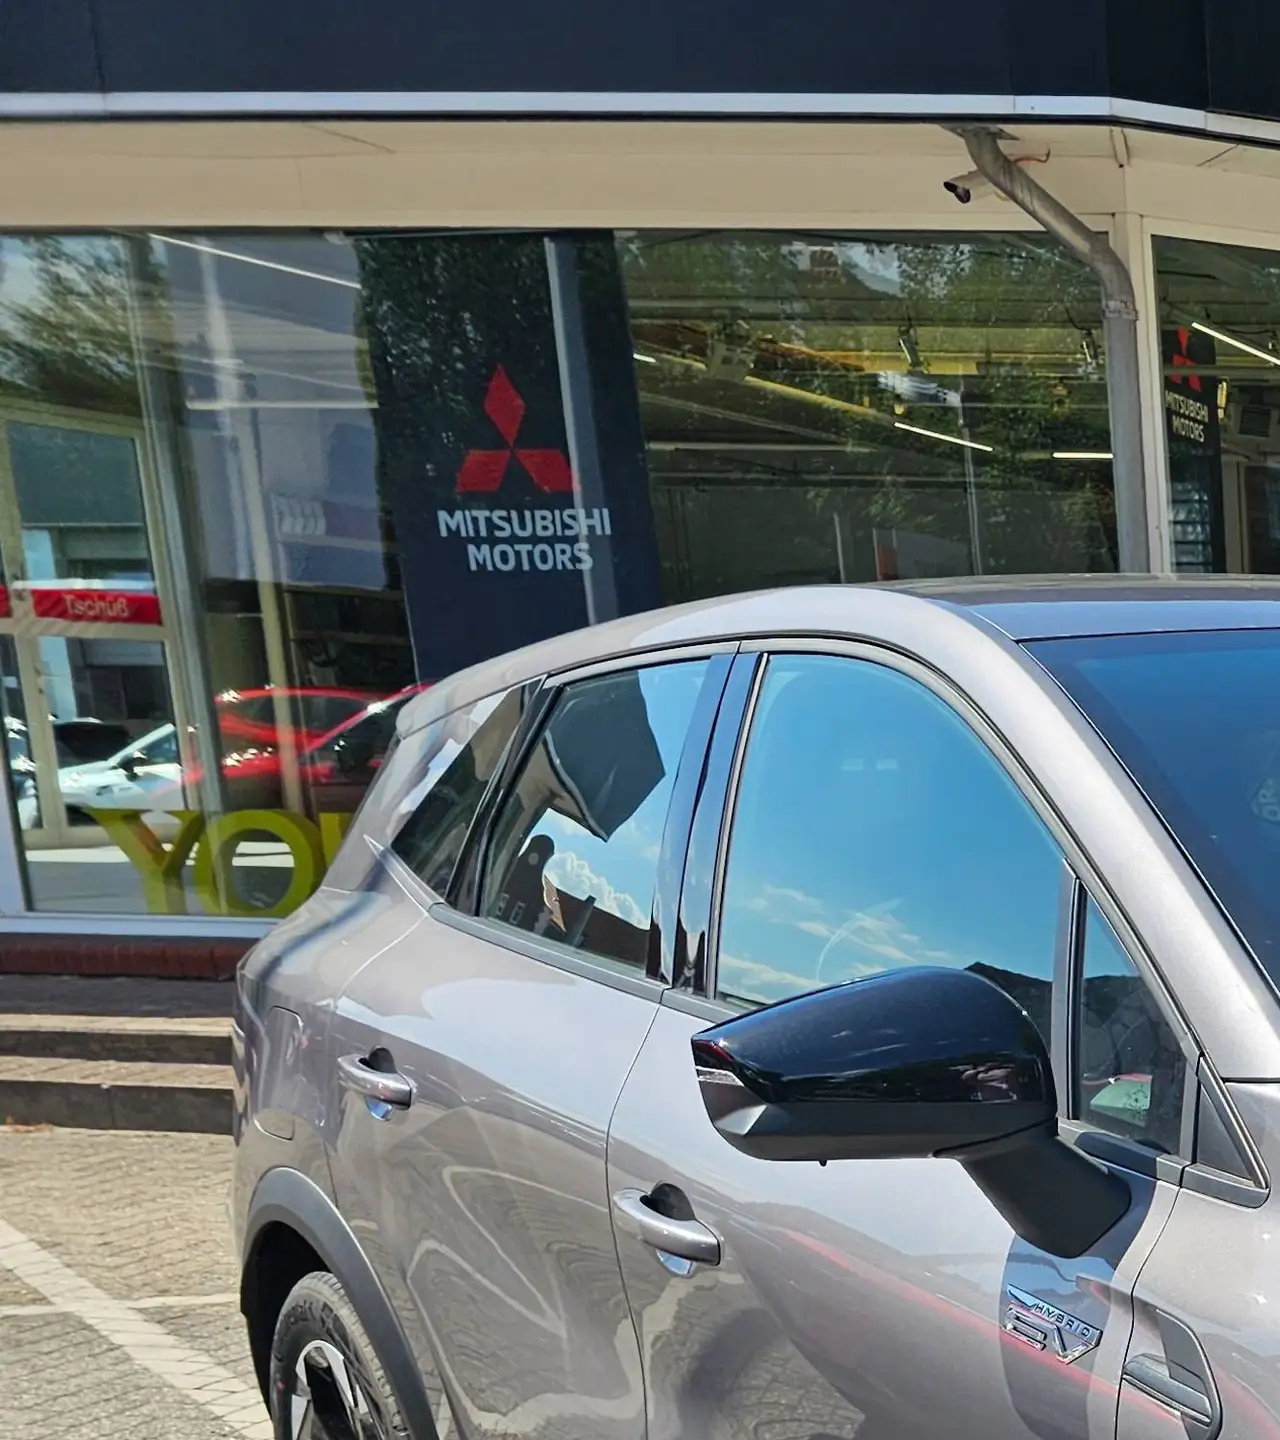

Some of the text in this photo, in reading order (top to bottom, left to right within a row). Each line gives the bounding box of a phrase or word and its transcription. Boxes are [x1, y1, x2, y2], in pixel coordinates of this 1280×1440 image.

[1165, 389, 1209, 422] MITSUBISHI
[1172, 414, 1205, 442] MOTORS
[437, 507, 612, 537] MITSUBISHI
[466, 542, 593, 571] MOTORS
[1034, 1303, 1091, 1340] HYBRID
